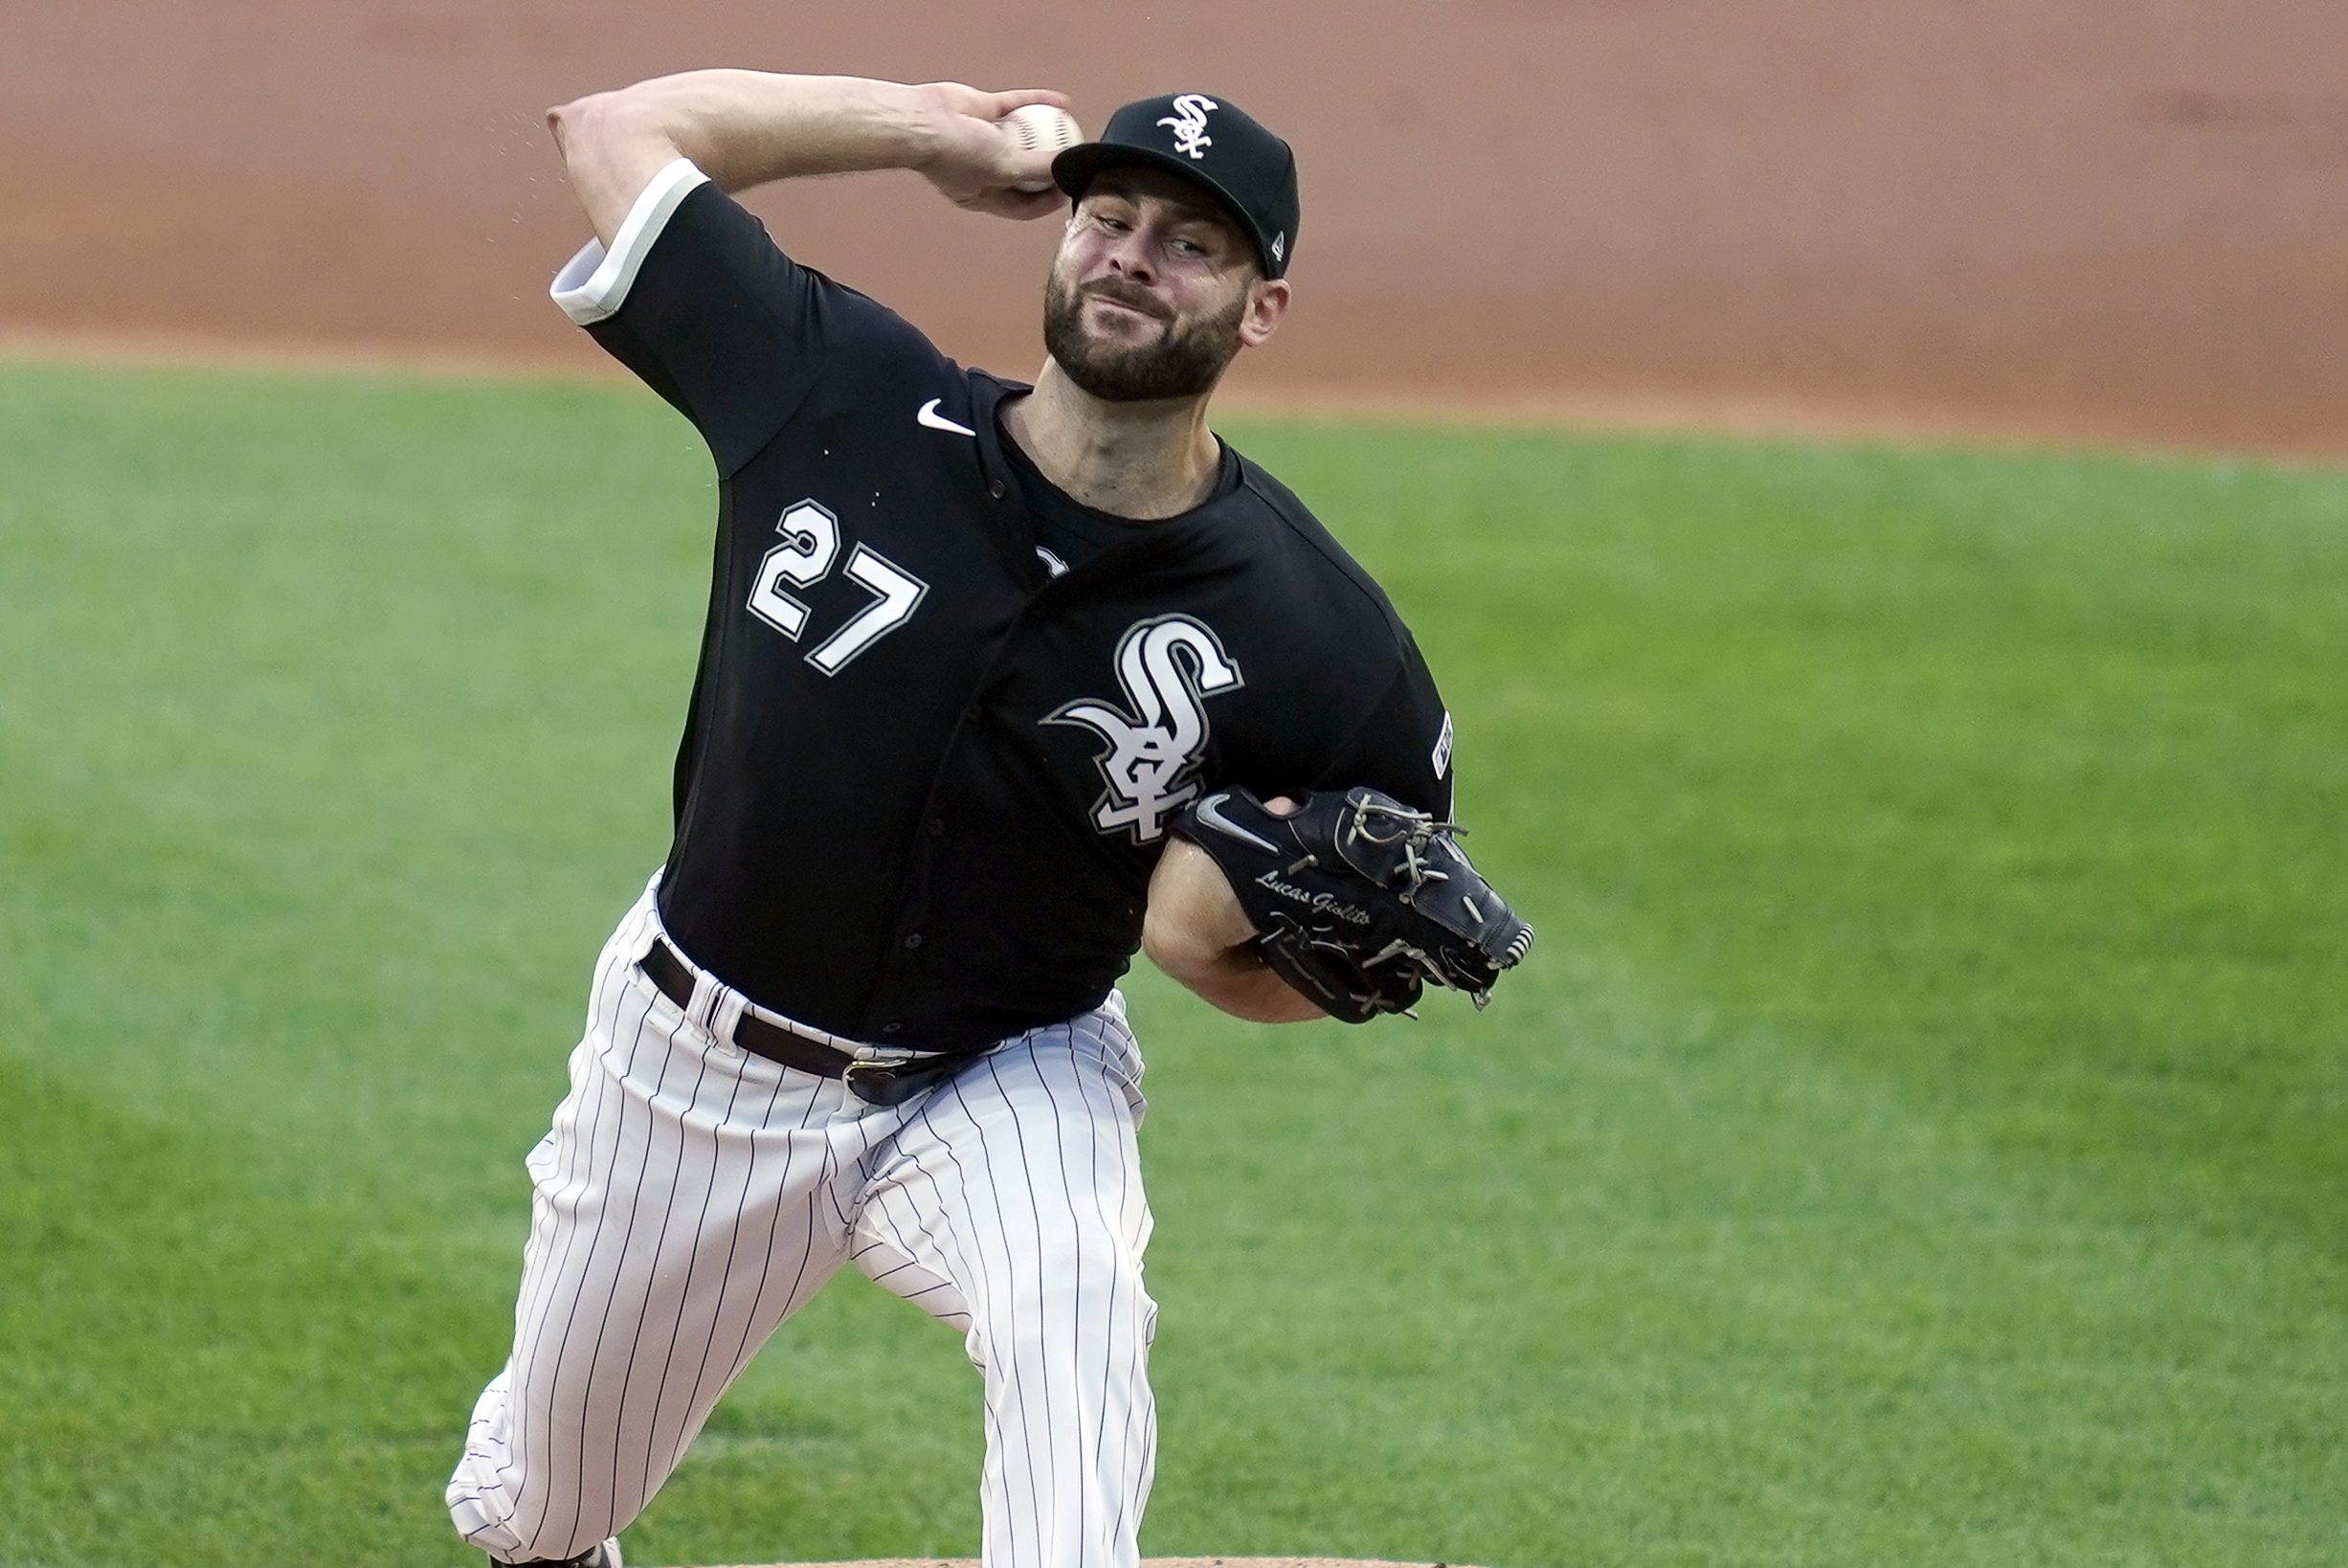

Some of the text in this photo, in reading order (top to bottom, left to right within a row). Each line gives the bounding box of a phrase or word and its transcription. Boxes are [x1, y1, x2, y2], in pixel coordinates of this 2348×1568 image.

[746, 498, 930, 678] 27
[1255, 869, 1370, 925] Lucas Giolito
